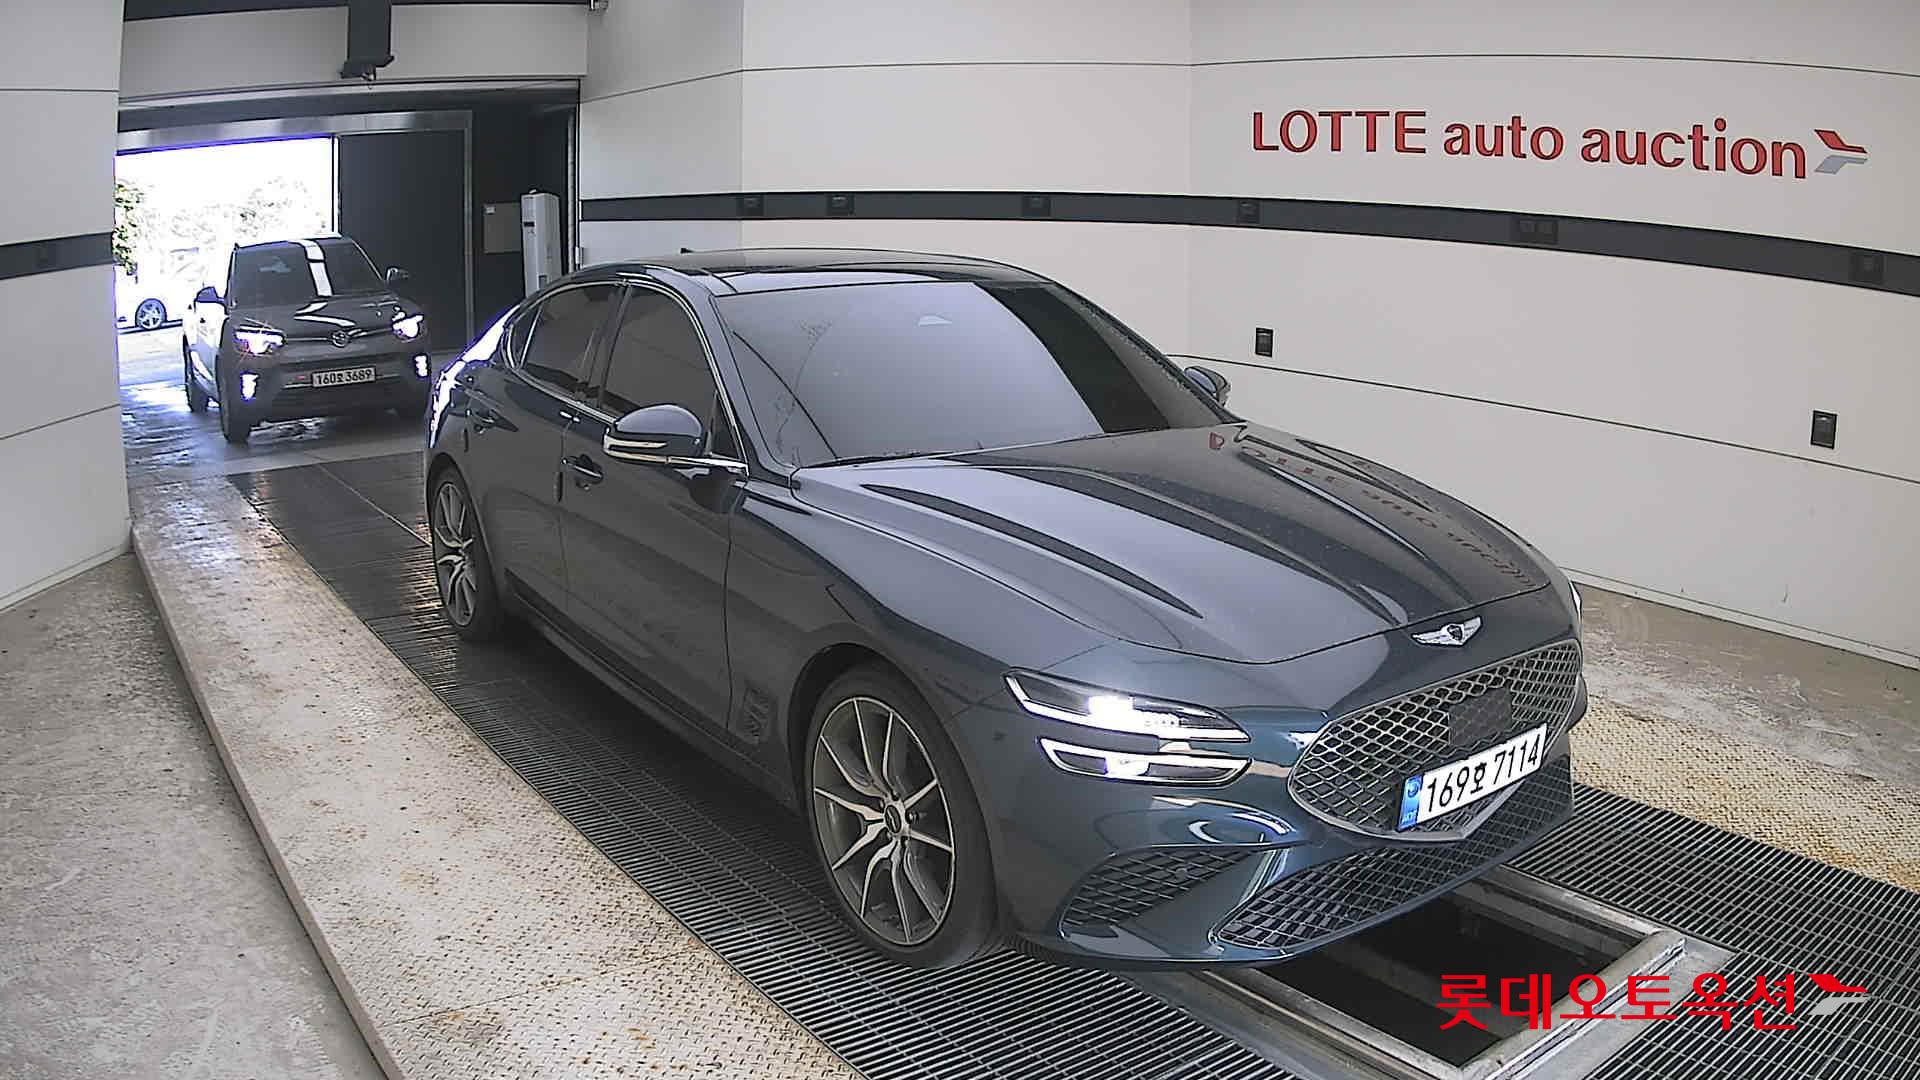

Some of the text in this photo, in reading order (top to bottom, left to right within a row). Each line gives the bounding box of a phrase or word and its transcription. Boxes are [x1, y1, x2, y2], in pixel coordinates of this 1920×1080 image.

[1252, 110, 1807, 180] LOTTE auto auction
[345, 368, 372, 382] 3689
[1426, 733, 1541, 813] 169호 7114
